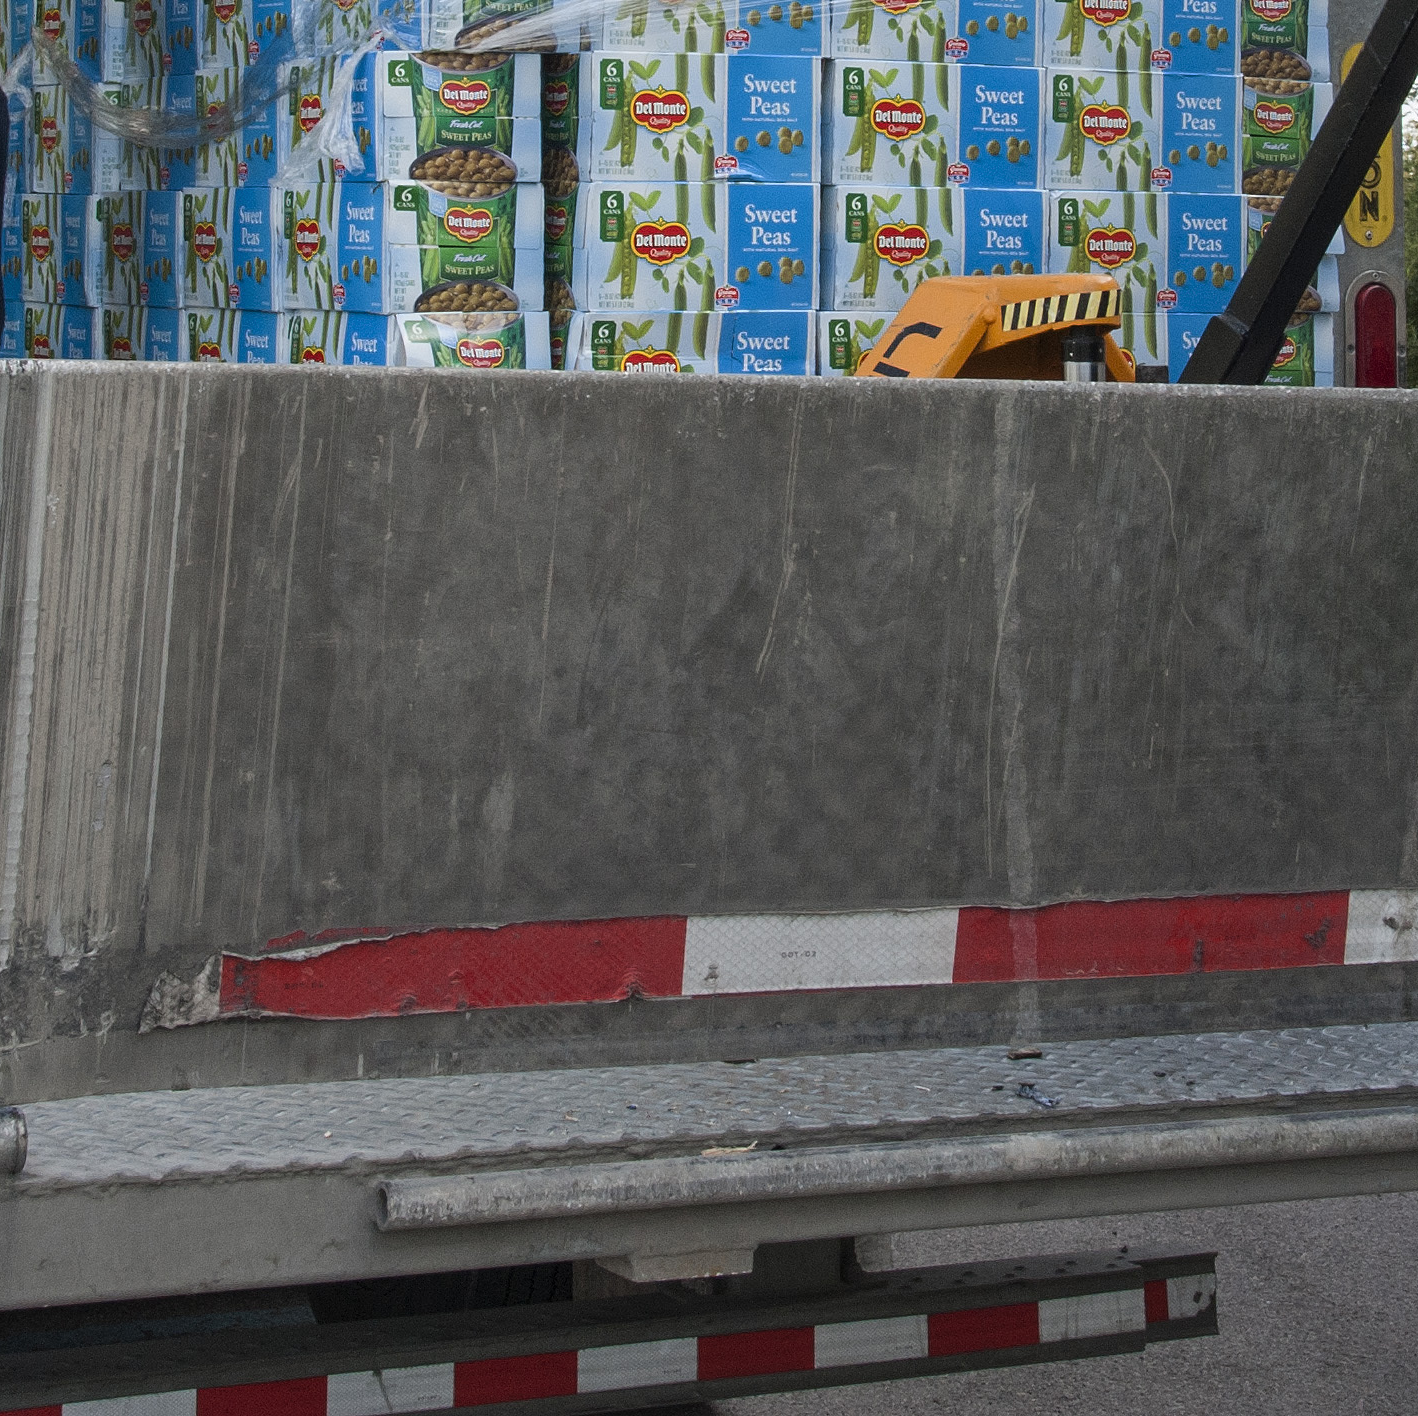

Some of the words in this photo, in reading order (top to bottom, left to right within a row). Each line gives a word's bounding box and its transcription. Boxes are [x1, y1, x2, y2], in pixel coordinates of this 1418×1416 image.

[1253, 0, 1265, 8] Del
[1266, 0, 1289, 9] Monte
[1096, 11, 1115, 19] Quality
[1252, 33, 1274, 43] SWEET
[1276, 34, 1292, 43] PEAS
[395, 63, 405, 77] 6
[606, 61, 617, 77] 6
[744, 74, 796, 93] Sweet
[849, 70, 858, 84] 6
[1058, 75, 1069, 91] 6
[444, 88, 458, 100] Del
[460, 89, 488, 100] Monte
[975, 85, 1024, 104] Sweet
[457, 101, 476, 109] Quality
[635, 102, 652, 114] Del
[654, 102, 686, 115] Monte
[750, 96, 790, 116] Peas
[1176, 92, 1222, 112] Sweet
[650, 117, 671, 126] Quality
[875, 110, 890, 121] Del
[892, 111, 922, 123] Monte
[982, 107, 1018, 125] Peas
[1083, 114, 1100, 127] Del
[1101, 115, 1129, 130] Monte
[1182, 112, 1216, 131] Peas
[1257, 110, 1268, 120] Del
[1269, 111, 1292, 121] Monte
[888, 124, 908, 133] Quality
[441, 130, 469, 142] SWEET
[472, 133, 492, 141] PEAS
[1255, 152, 1278, 162] SWEET
[402, 188, 412, 202] 6
[607, 194, 617, 208] 6
[851, 196, 862, 211] 6
[1064, 201, 1074, 215] 6
[150, 209, 170, 226] Sweet
[239, 207, 263, 225] Sweet
[346, 202, 373, 222] Sweet
[745, 204, 797, 223] Sweet
[980, 209, 1028, 228] Sweet
[448, 216, 462, 226] Del
[463, 218, 490, 228] Monte
[1182, 213, 1228, 231] Sweet
[151, 230, 166, 246] Peas
[241, 229, 259, 245] Peas
[349, 225, 370, 244] Peas
[636, 234, 653, 246] Del
[654, 234, 687, 247] Monte
[752, 227, 791, 245] Peas
[986, 230, 1022, 249] Peas
[877, 235, 893, 248] Del
[895, 236, 927, 249] Monte
[1089, 238, 1104, 251] Del
[1105, 238, 1133, 252] Monte
[1188, 233, 1222, 252] Peas
[650, 249, 672, 257] Quality
[891, 251, 912, 259] Quality
[445, 264, 472, 275] SWEET
[475, 265, 494, 274] PEAS
[412, 322, 423, 334] 6
[598, 323, 609, 337] 6
[834, 321, 844, 336] 6
[245, 329, 269, 347] Sweet
[352, 332, 377, 350] Sweet
[737, 332, 790, 350] Sweet
[832, 334, 848, 342] CANS
[460, 346, 474, 356] Del
[475, 348, 502, 358] Monte
[626, 362, 642, 372] Del
[644, 363, 676, 372] Monte
[742, 354, 781, 372] Peas
